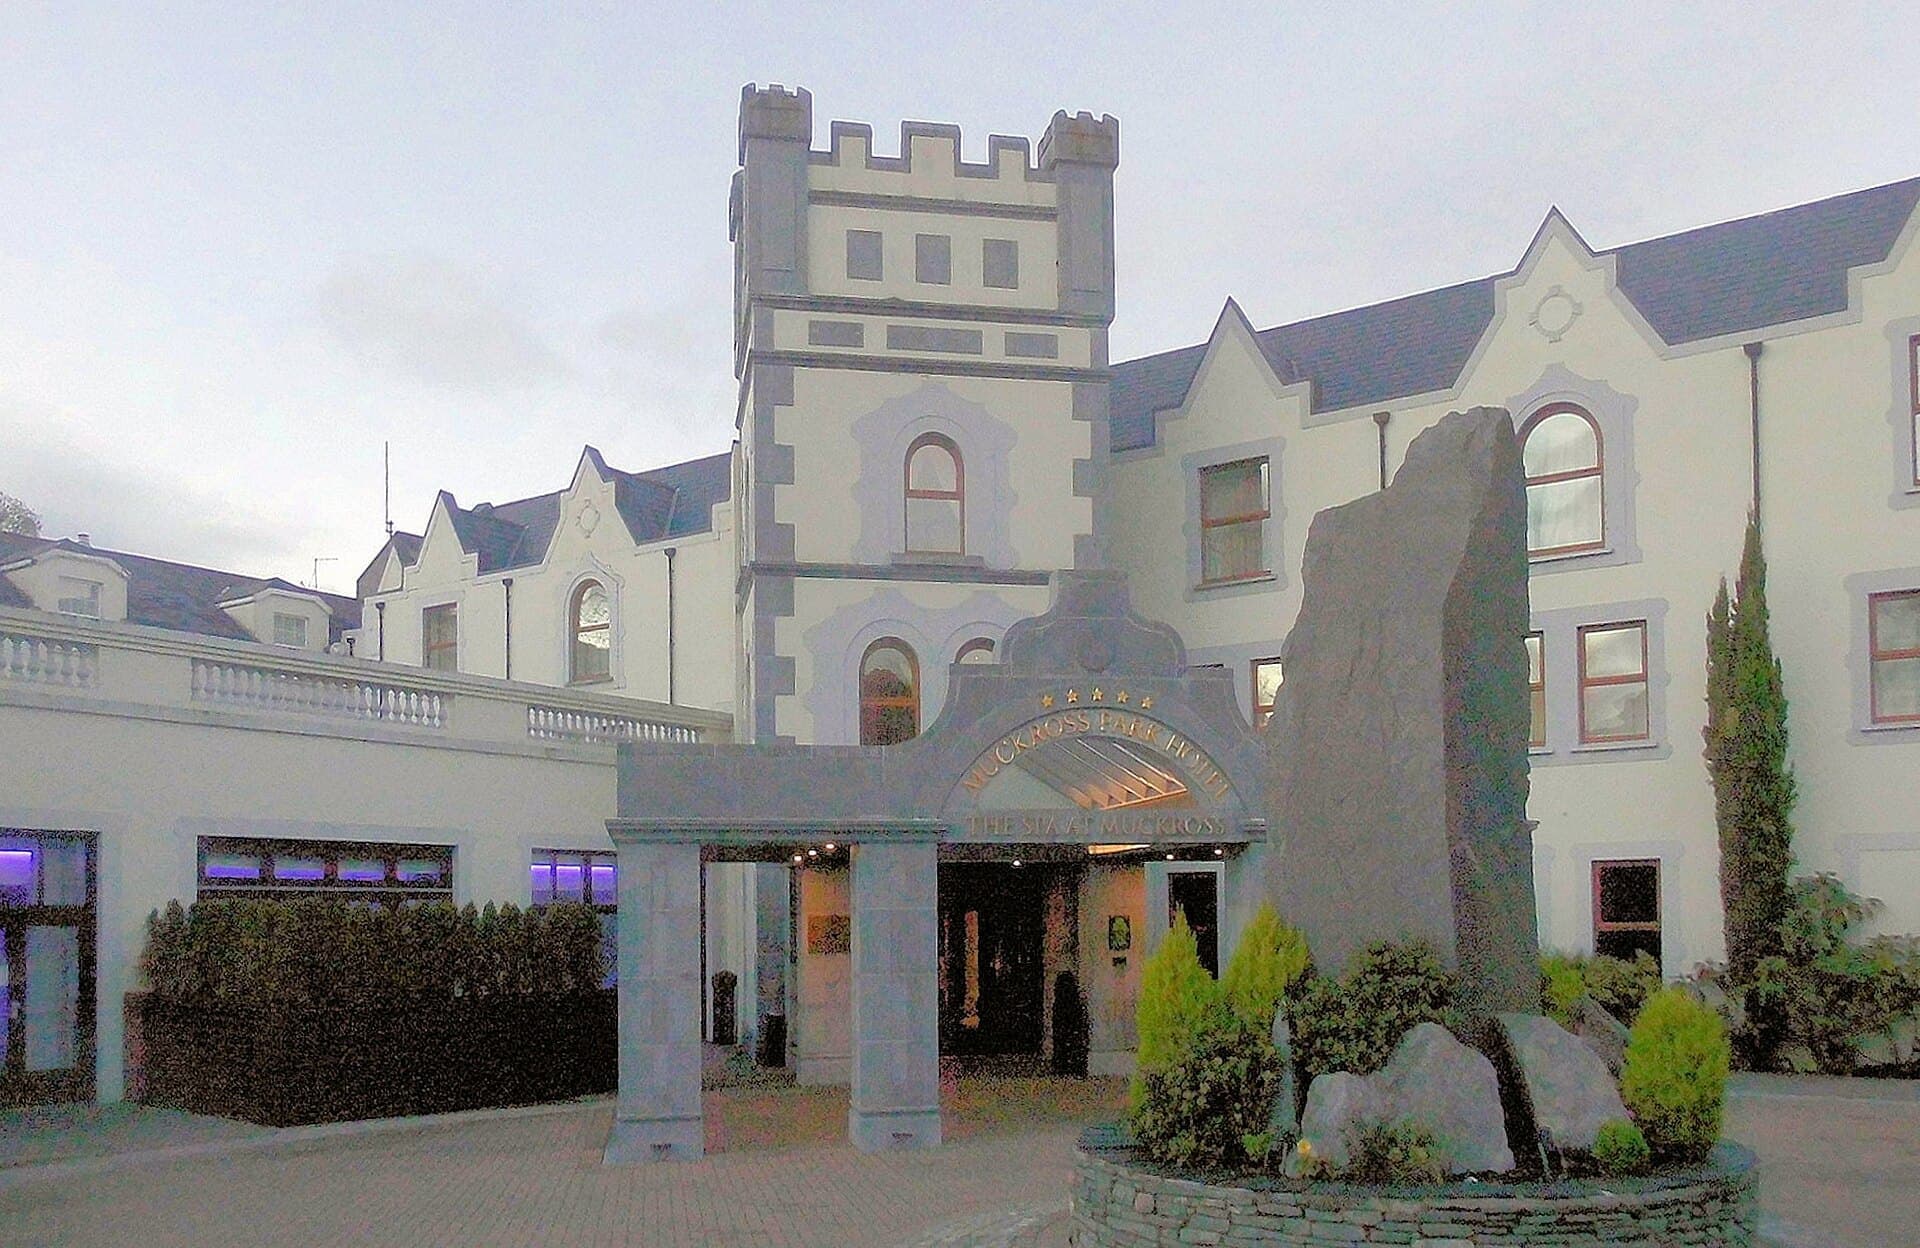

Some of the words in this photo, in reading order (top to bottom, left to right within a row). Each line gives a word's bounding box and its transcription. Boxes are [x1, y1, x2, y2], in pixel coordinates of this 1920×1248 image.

[962, 712, 1090, 798] MUCKROSS
[1098, 711, 1158, 742] PARK
[1164, 734, 1229, 801] HOTEL
[966, 815, 1012, 836] THE
[1022, 815, 1058, 836] SPA
[1065, 815, 1092, 835] AT
[1101, 815, 1226, 836] MUCKROSS
